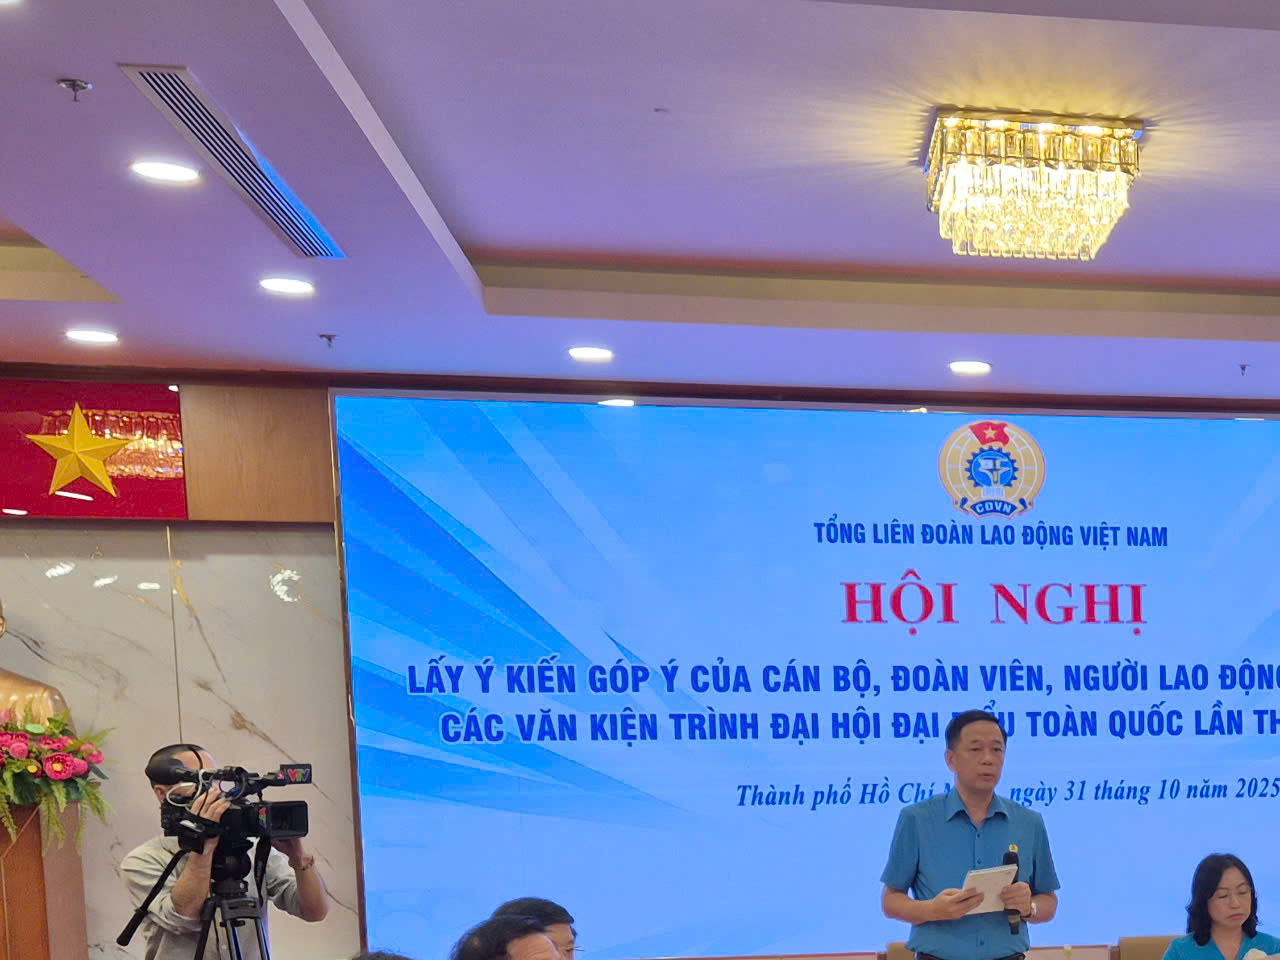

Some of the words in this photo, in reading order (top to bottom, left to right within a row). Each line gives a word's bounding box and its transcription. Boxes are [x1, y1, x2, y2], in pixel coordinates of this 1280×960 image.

[813, 513, 866, 544] TỔNG
[872, 519, 915, 545] LIÊN
[921, 519, 973, 545] ĐOÀN
[980, 525, 1015, 545] LAO
[1021, 520, 1074, 550] ĐỘNG
[1079, 521, 1121, 551] VIỆT
[1126, 526, 1168, 547] NAM
[841, 568, 958, 636] HỘI
[990, 582, 1148, 636] NGHỊ
[407, 655, 464, 694] LẤY
[474, 657, 494, 694] Ý
[506, 653, 576, 694] KIẾN
[588, 658, 650, 694] GÓP
[660, 658, 680, 693] Ý
[690, 655, 752, 693] CỦA
[762, 657, 821, 693] CÁN
[833, 658, 881, 699] BỘ,
[890, 657, 969, 692] ĐOÀN
[979, 661, 1053, 697] VIÊN,
[1064, 657, 1148, 692] NGƯỜI
[1159, 664, 1209, 691] LAO
[441, 705, 504, 743] CÁC
[515, 708, 577, 742] VĂN
[590, 706, 658, 748] KIỆN
[668, 705, 759, 740] TRÌNH
[769, 712, 819, 746] ĐẠI
[831, 705, 881, 745] HỘI
[891, 711, 939, 745] ĐẠI
[1025, 704, 1098, 738] TOÀN
[1109, 700, 1184, 740] QUỐC
[1194, 699, 1244, 736] LẦN
[737, 784, 806, 806] Thành
[810, 777, 853, 811] phố
[858, 776, 890, 804] Hồ
[898, 782, 936, 804] Chí
[1009, 781, 1058, 807] ngày
[1064, 780, 1086, 801] 31
[1094, 778, 1151, 805] tháng
[1158, 779, 1181, 800] 10
[1186, 779, 1228, 799] năm
[1235, 777, 1280, 799] 2025
